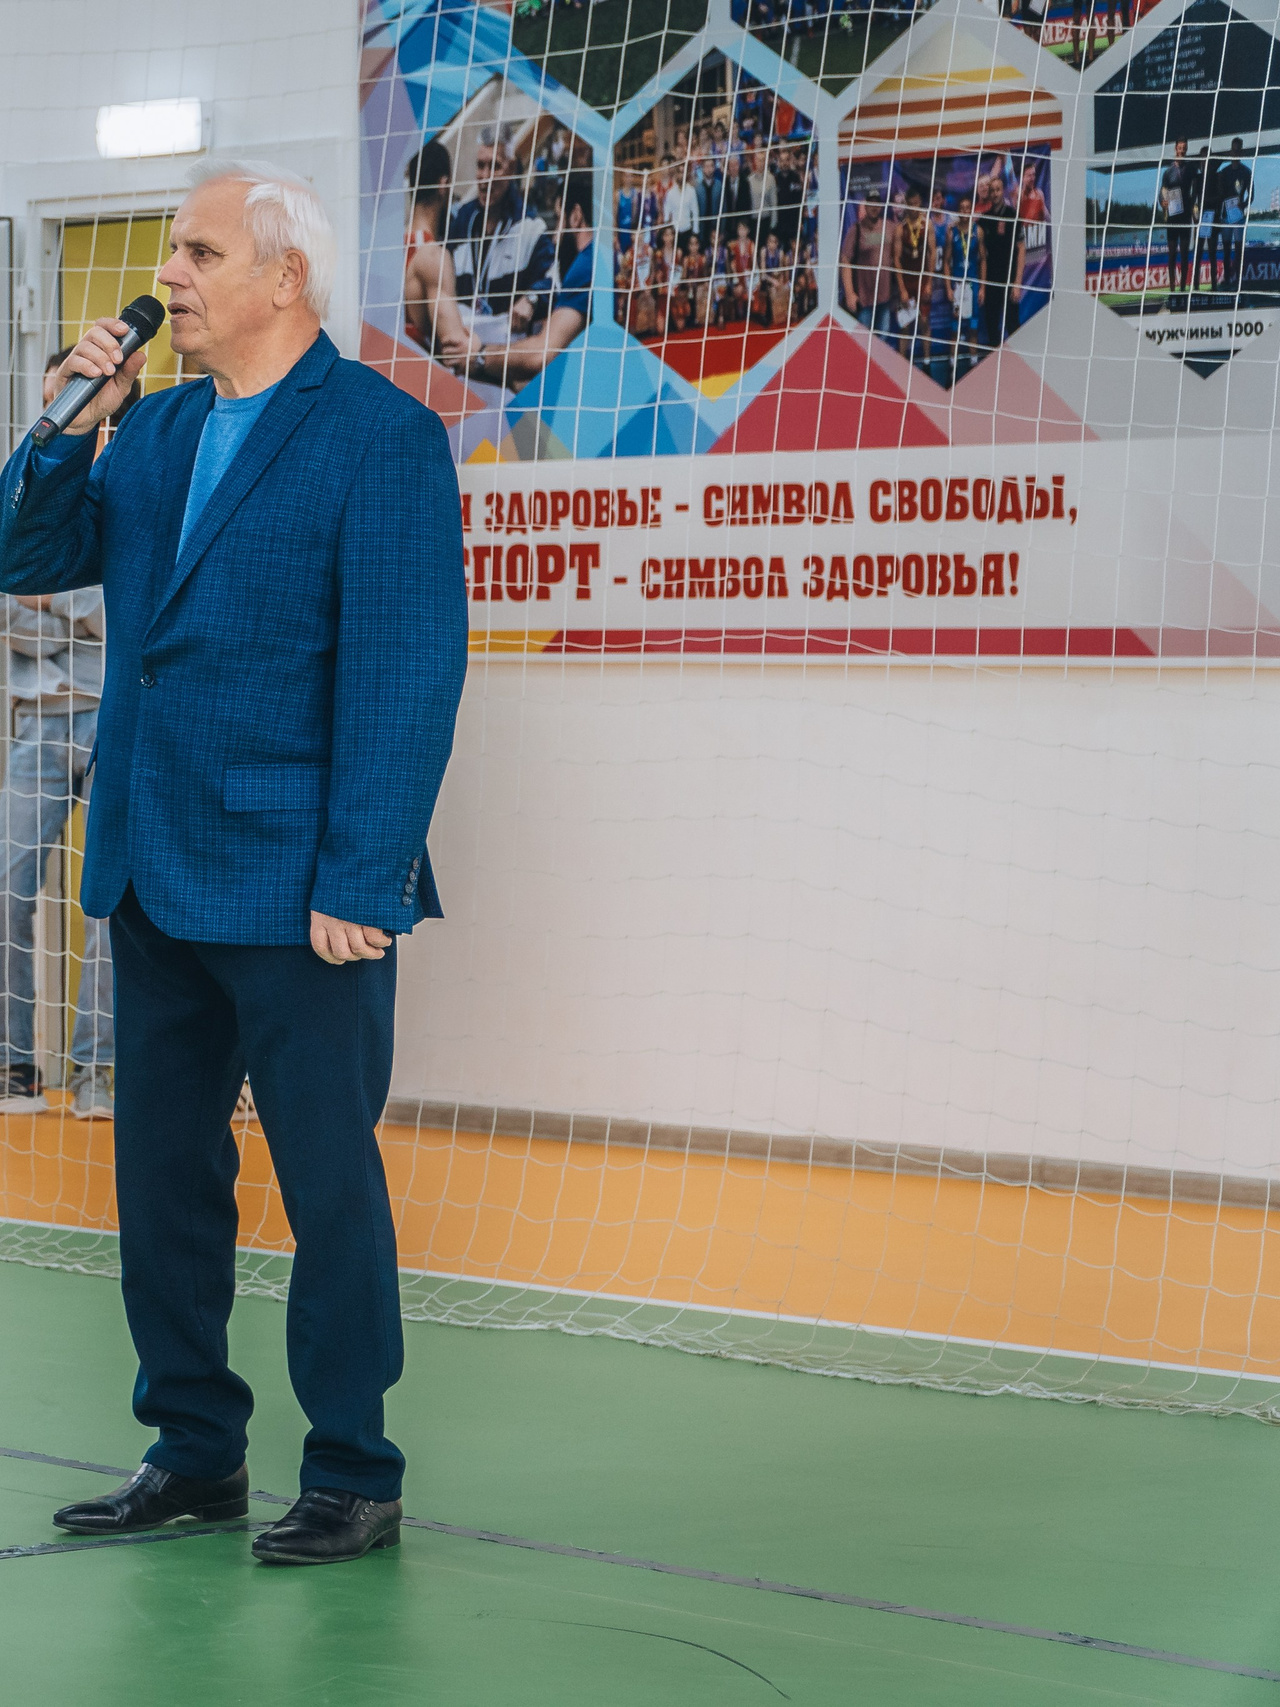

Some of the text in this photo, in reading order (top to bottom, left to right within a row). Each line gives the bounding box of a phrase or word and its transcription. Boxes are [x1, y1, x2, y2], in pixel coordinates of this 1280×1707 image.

[1145, 321, 1264, 345] мужчины 1000
[485, 486, 662, 535] ЗДОРОВЬЕ
[702, 479, 855, 527] СИМВОЛ
[869, 474, 1078, 525] СВОБОДЫ,
[464, 543, 600, 601] ПОРТ
[641, 555, 789, 601] СИМВОЛ
[803, 552, 1019, 601] ЗДОРОВЬЯ!
